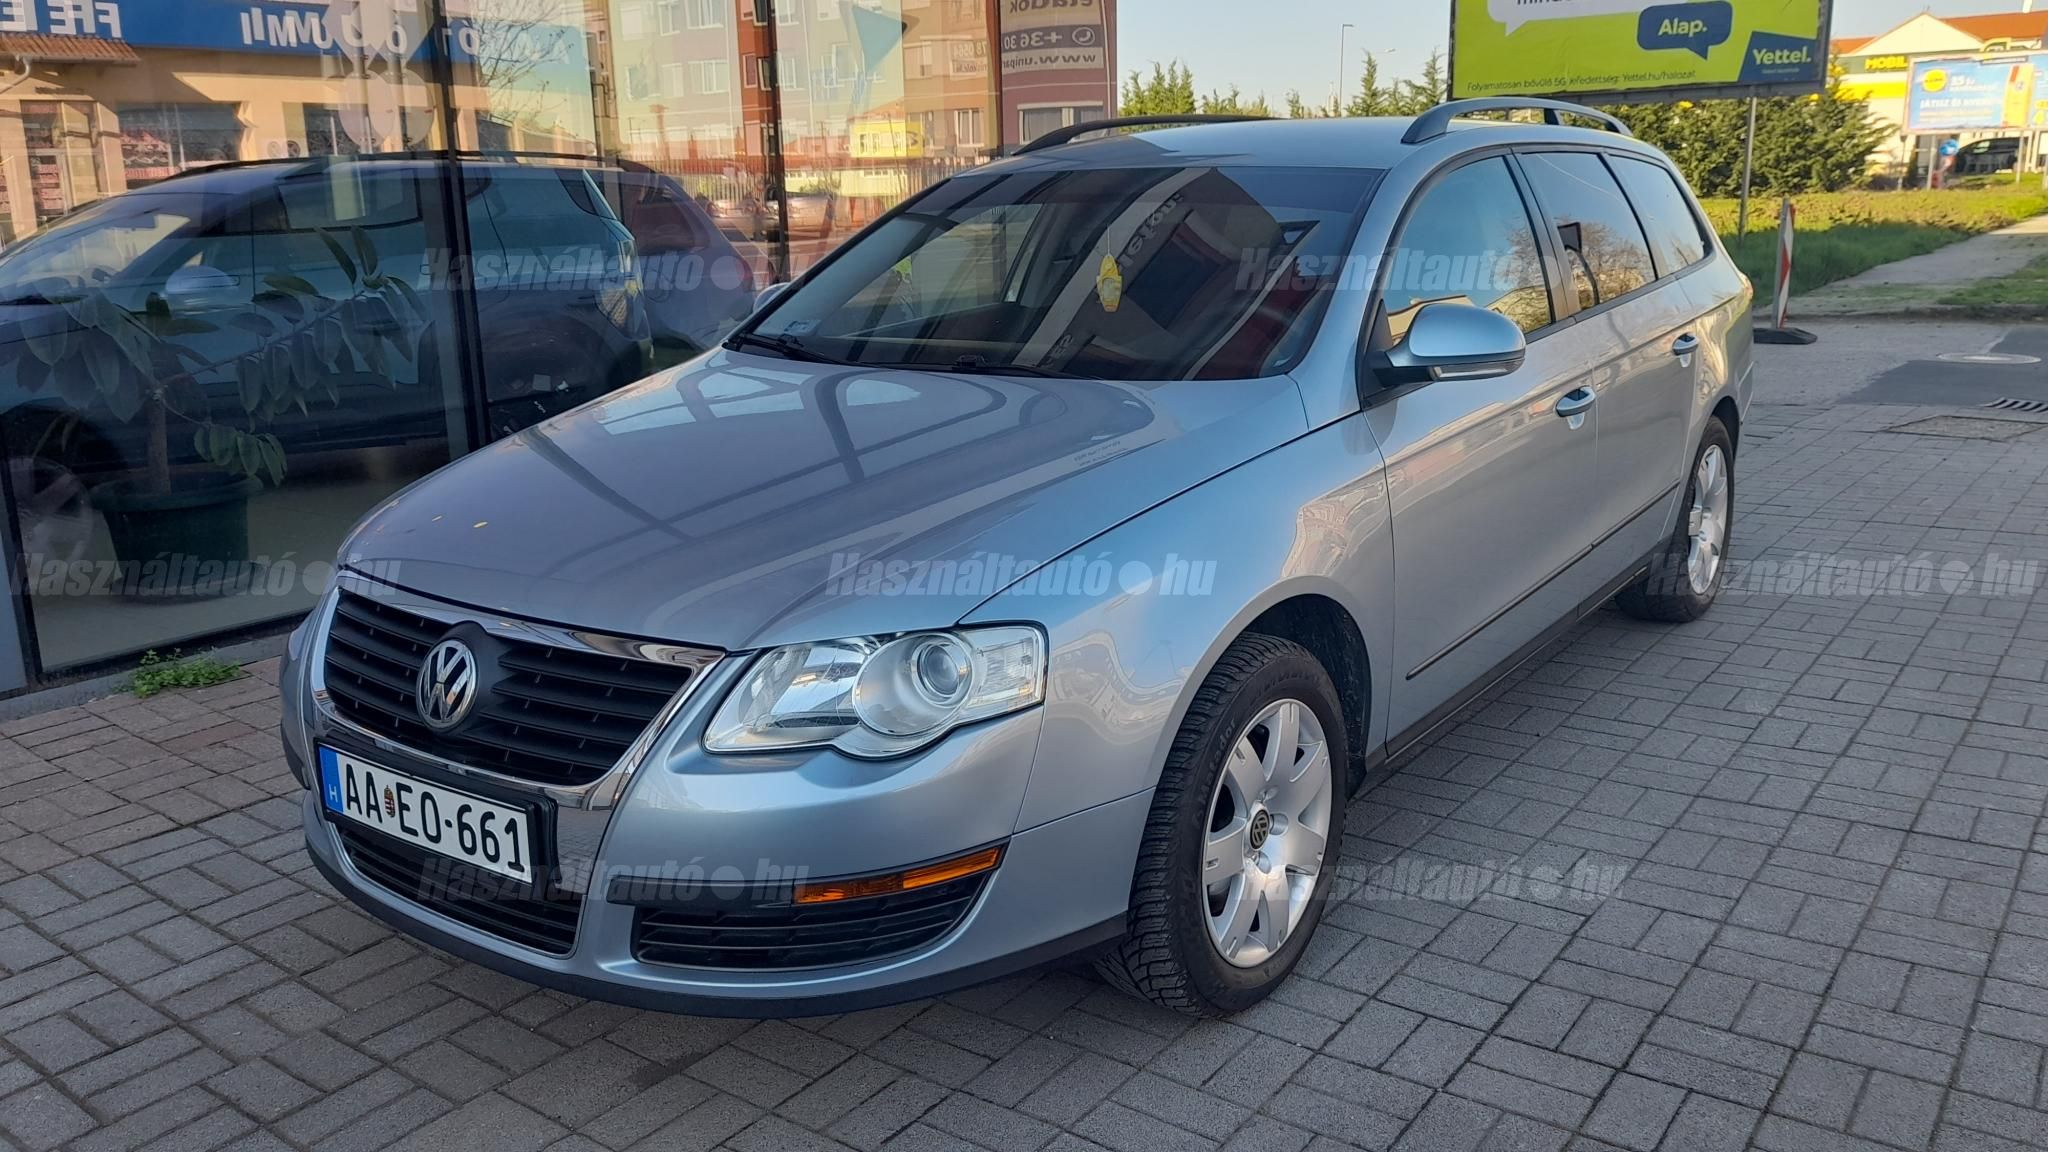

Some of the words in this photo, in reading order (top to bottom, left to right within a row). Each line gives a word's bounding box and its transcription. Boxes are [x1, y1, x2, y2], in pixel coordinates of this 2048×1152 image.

[1658, 17, 1708, 37] Alap.
[1752, 46, 1812, 65] Yettel.
[346, 763, 383, 823] AA
